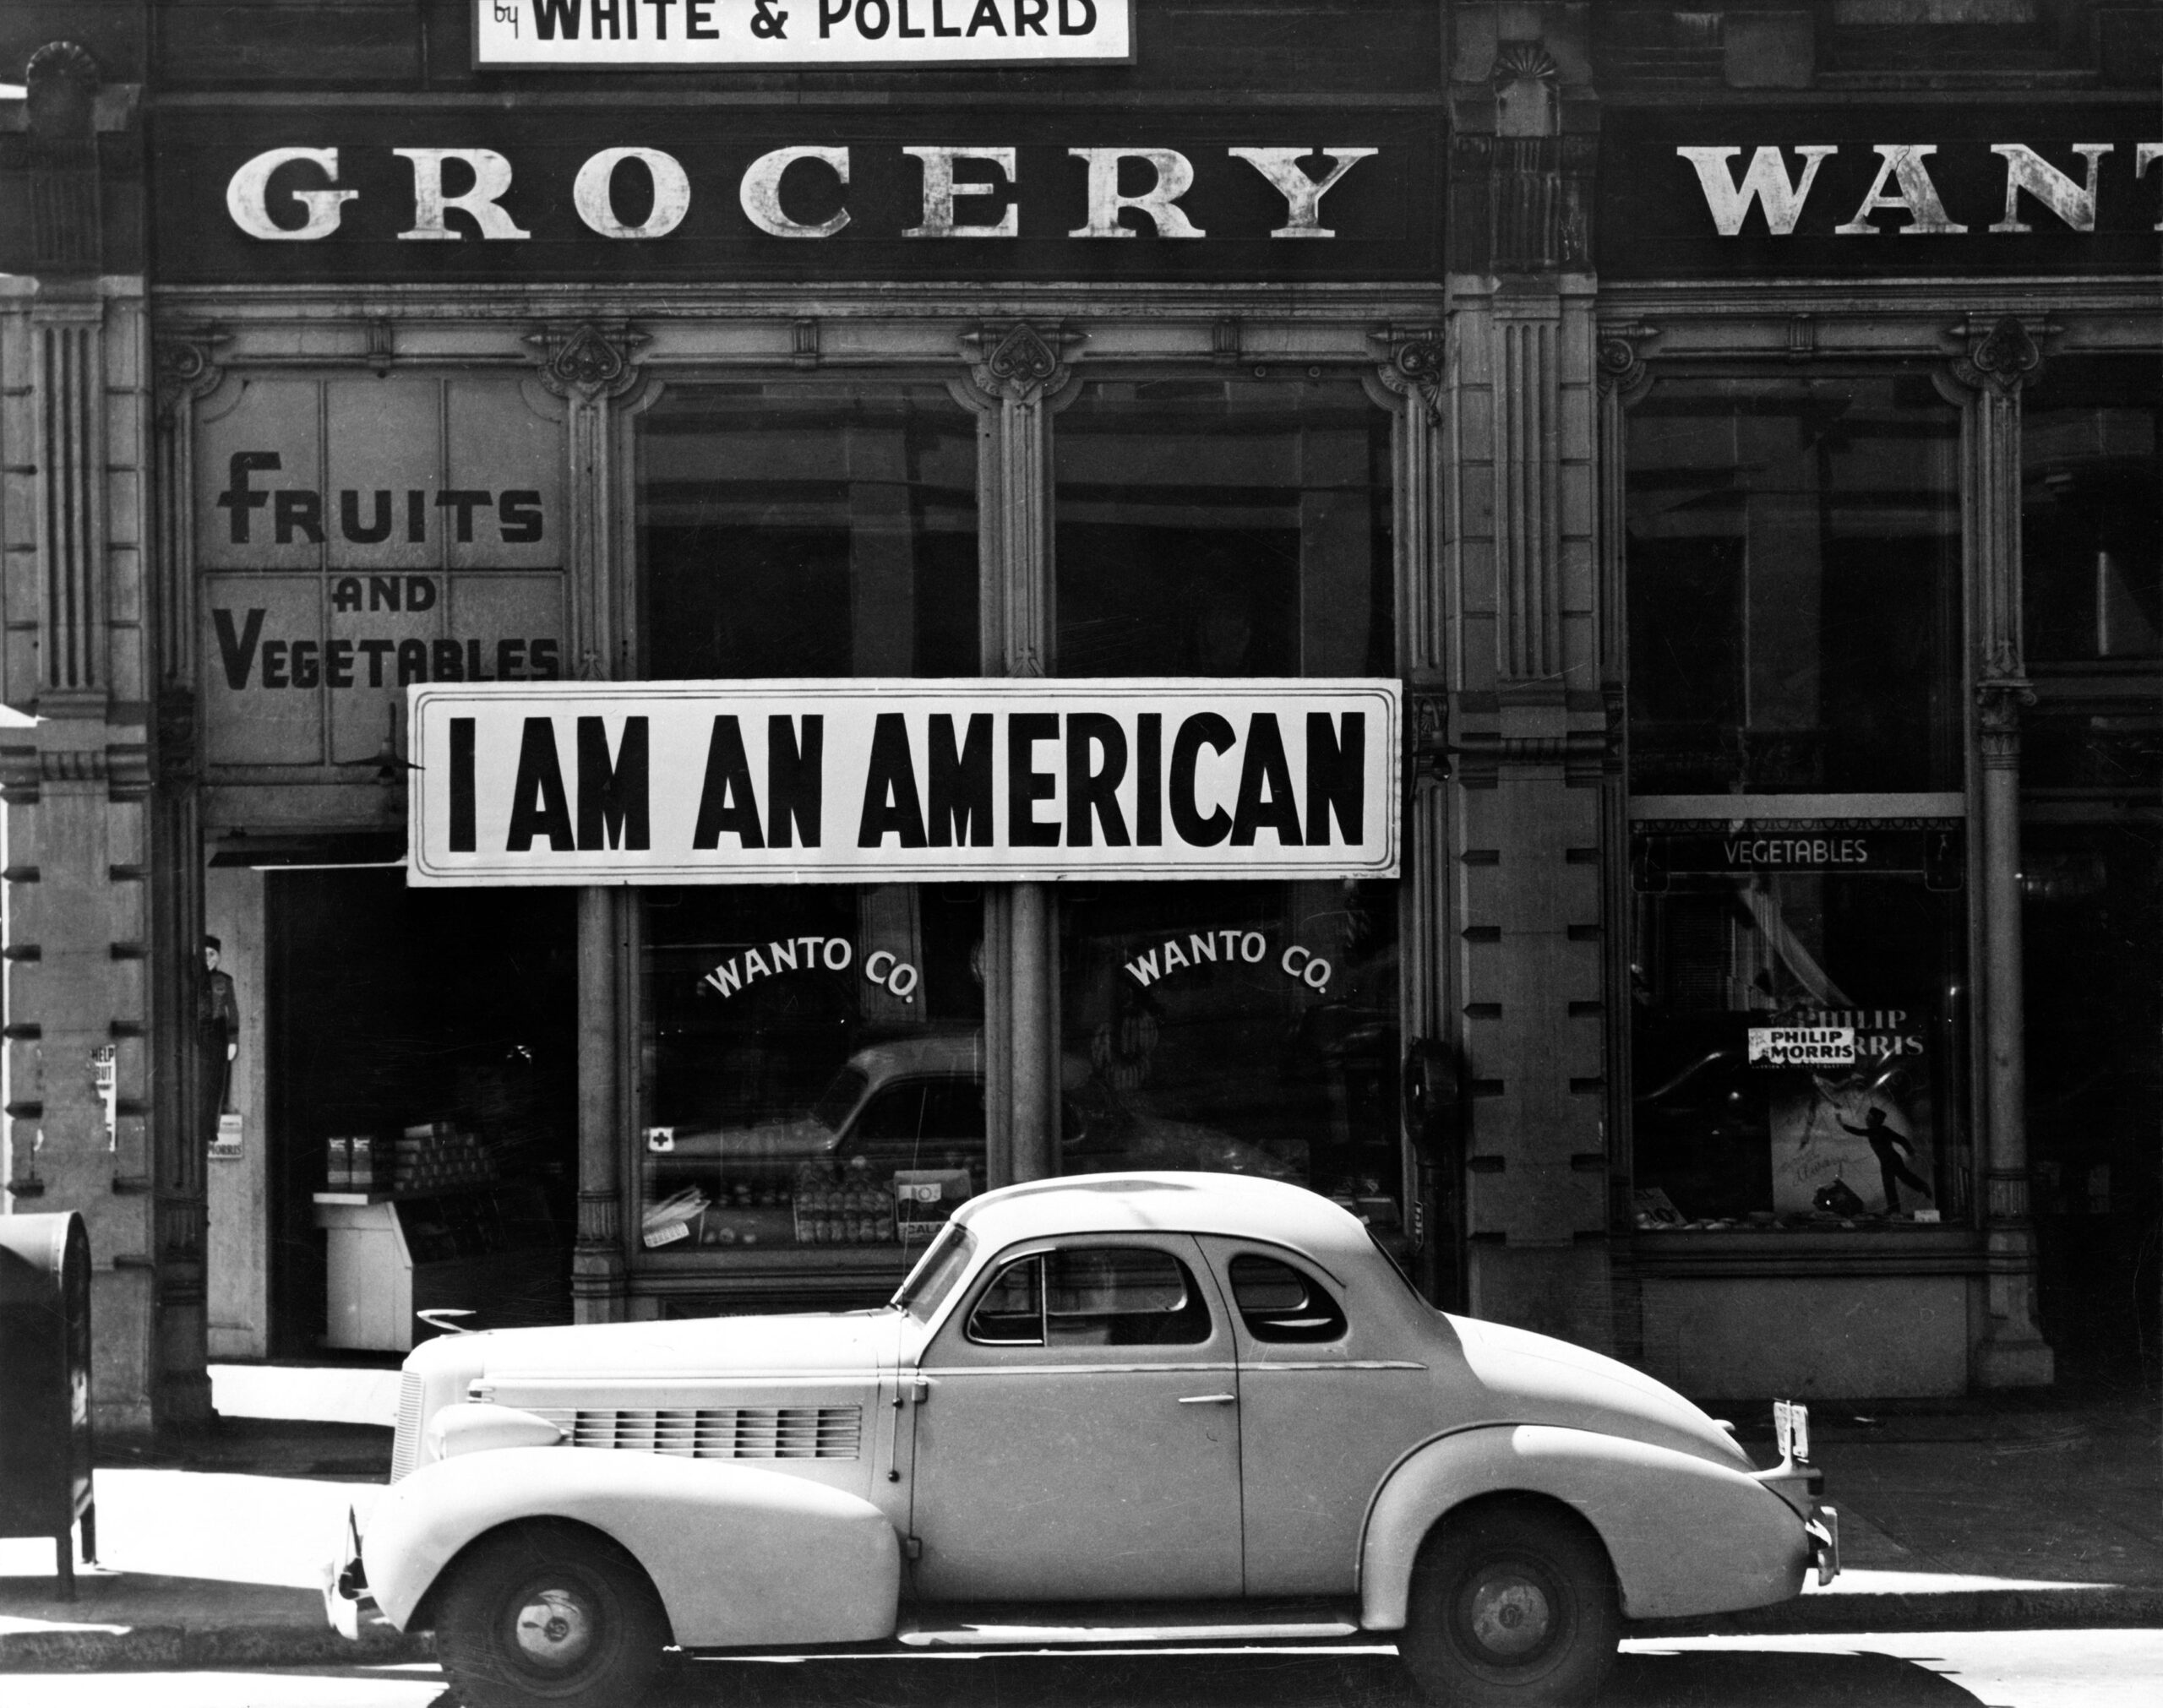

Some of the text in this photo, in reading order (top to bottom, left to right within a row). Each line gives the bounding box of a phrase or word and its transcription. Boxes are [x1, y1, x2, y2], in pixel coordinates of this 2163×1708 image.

[494, 0, 1098, 40] by WHITE & POLLARD
[225, 145, 1379, 240] GROCERY
[331, 575, 437, 612] AND
[449, 711, 1366, 852] I AM AN AMERICAN
[1724, 839, 1868, 864] VEGETABLES
[705, 937, 918, 1004] WANTO CO.
[1124, 930, 1332, 994] WANTO CO.
[1770, 1031, 1843, 1044] PHILIP
[1770, 1045, 1853, 1058] MORRIS
